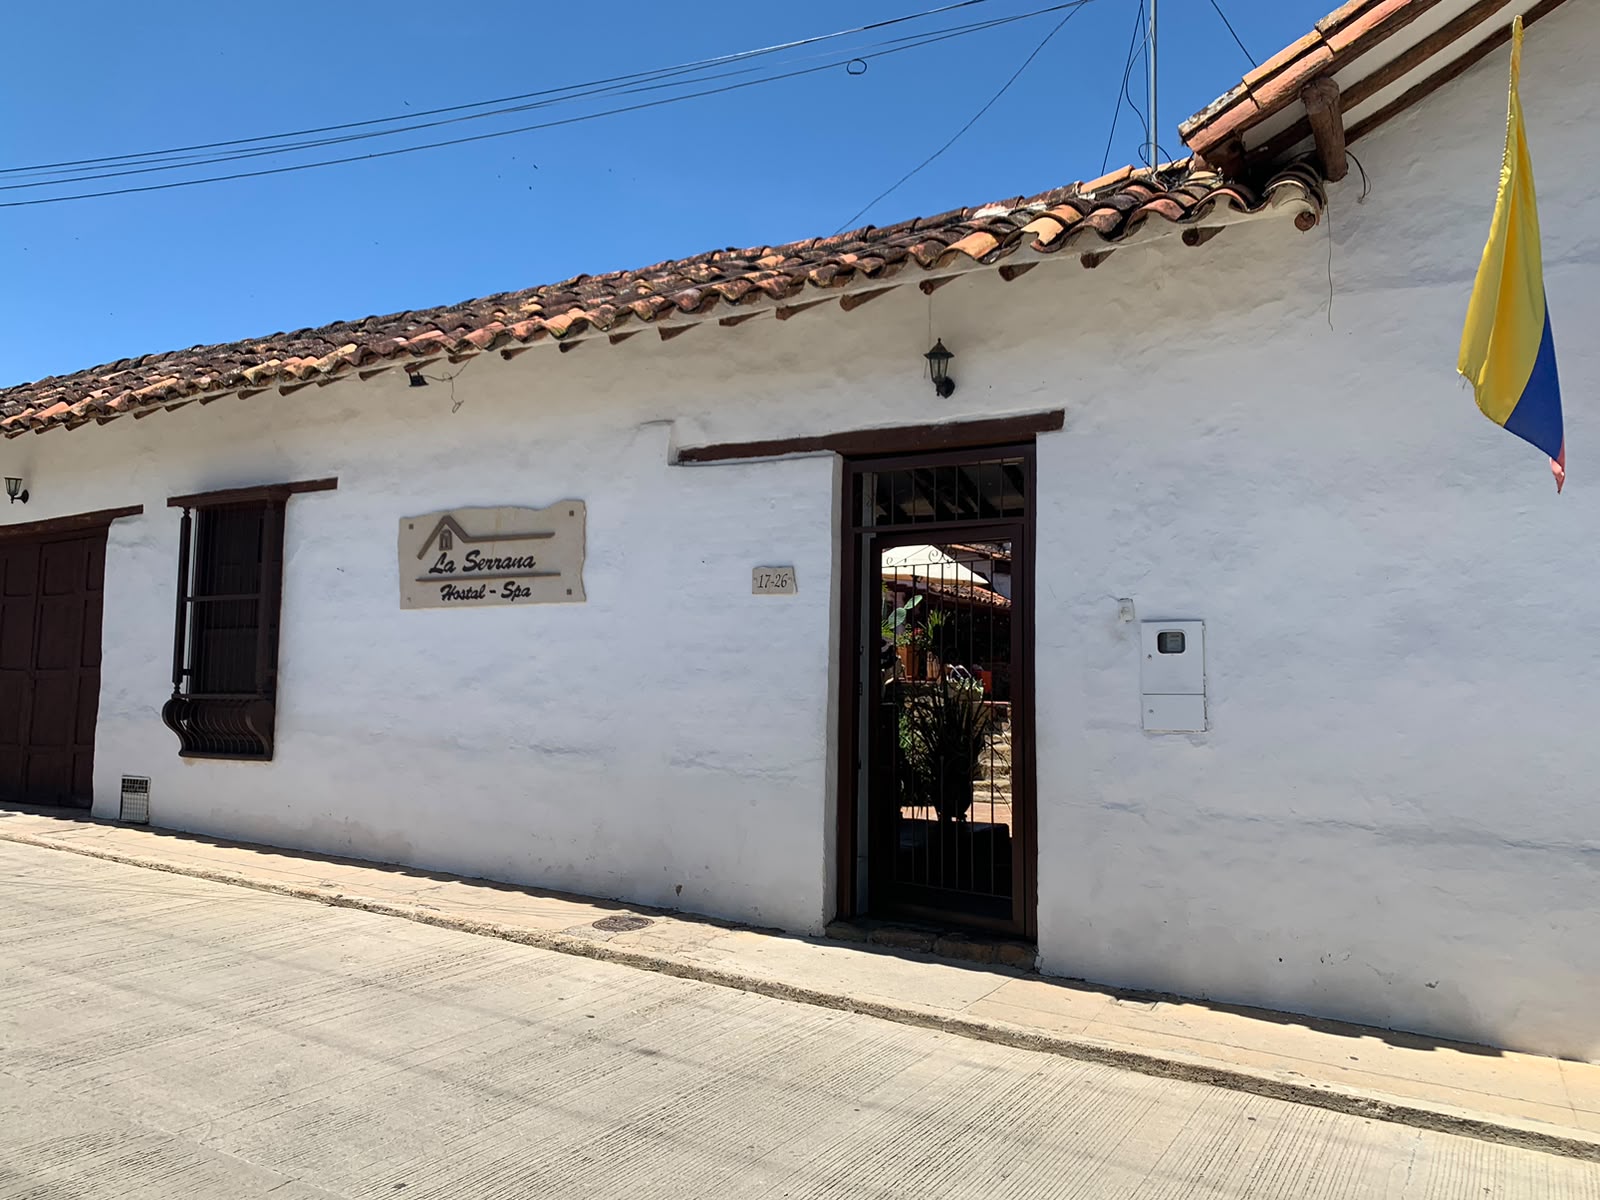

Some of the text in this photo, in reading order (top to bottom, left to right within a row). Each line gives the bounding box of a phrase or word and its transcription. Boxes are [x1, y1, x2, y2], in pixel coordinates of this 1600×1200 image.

[428, 549, 536, 574] La Serrana
[440, 583, 486, 601] Hostal
[501, 581, 532, 601] Spa
[757, 573, 788, 589] 17-26
